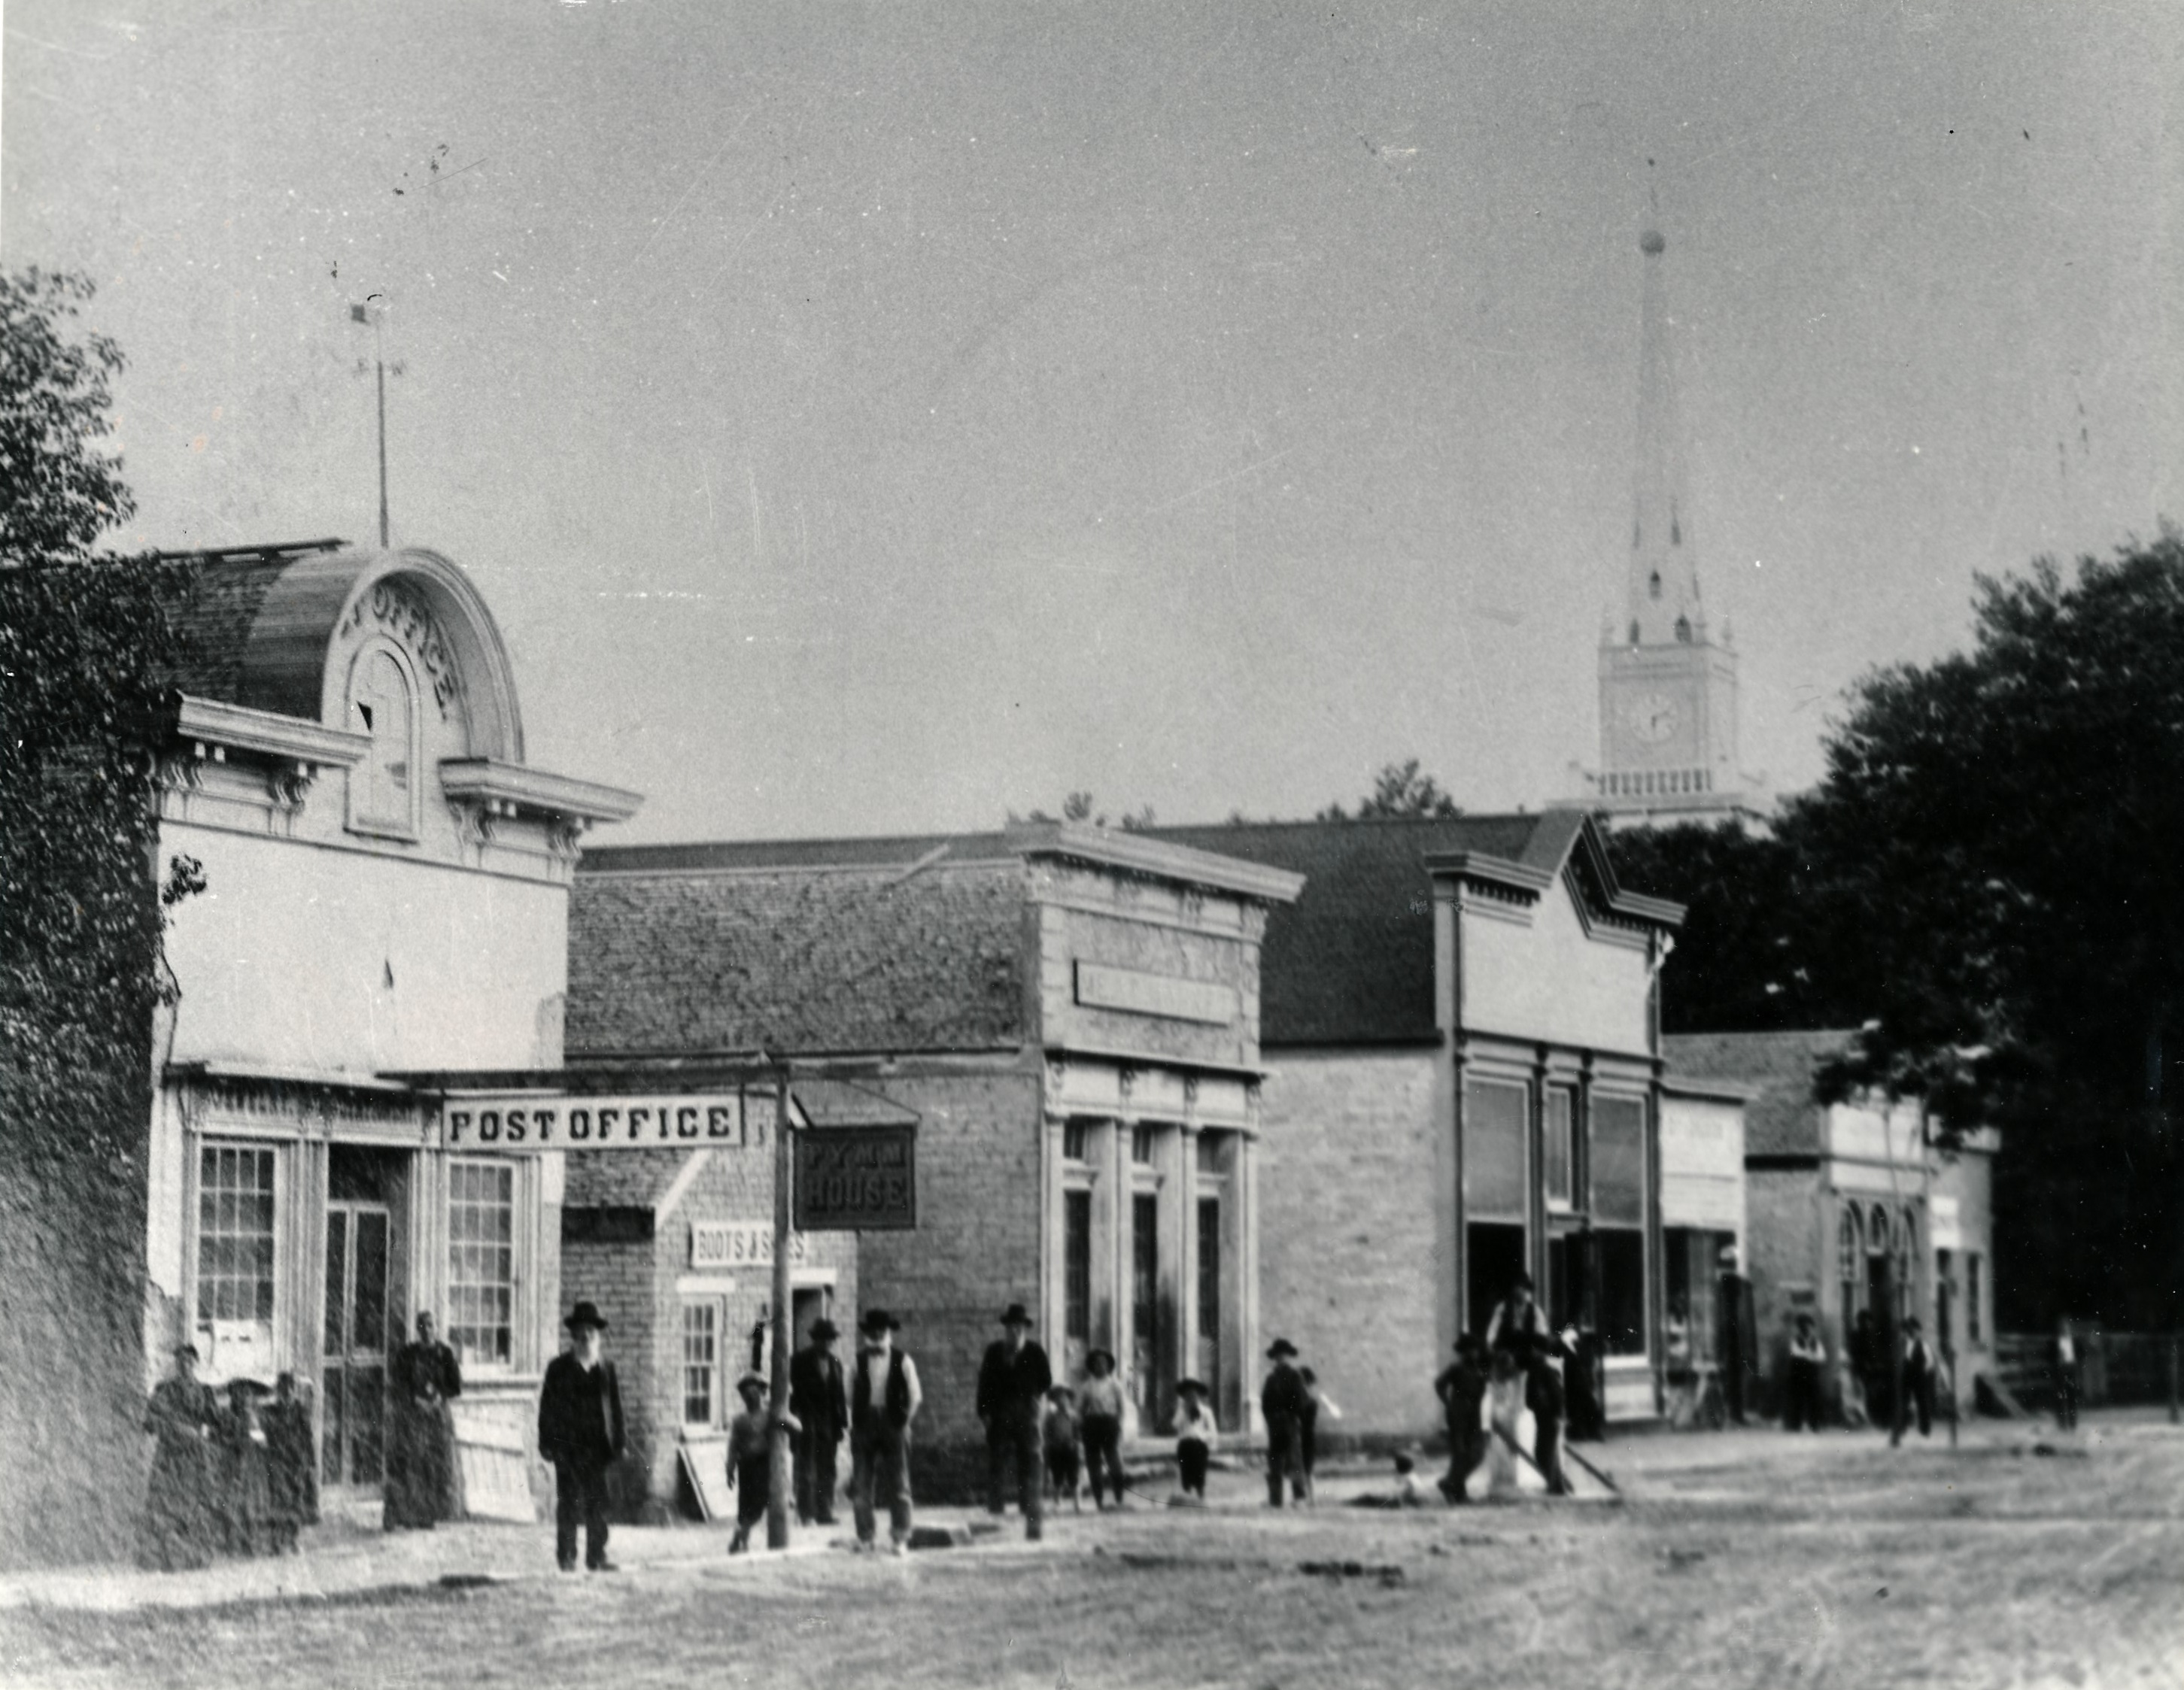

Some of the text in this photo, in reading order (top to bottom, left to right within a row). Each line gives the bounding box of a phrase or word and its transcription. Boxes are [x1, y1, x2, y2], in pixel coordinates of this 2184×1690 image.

[451, 1110, 554, 1142] POST
[570, 1106, 731, 1140] OFFICE
[806, 1172, 906, 1210] HOUSE
[699, 1231, 743, 1260] BOOTS
[749, 1230, 757, 1260] &
